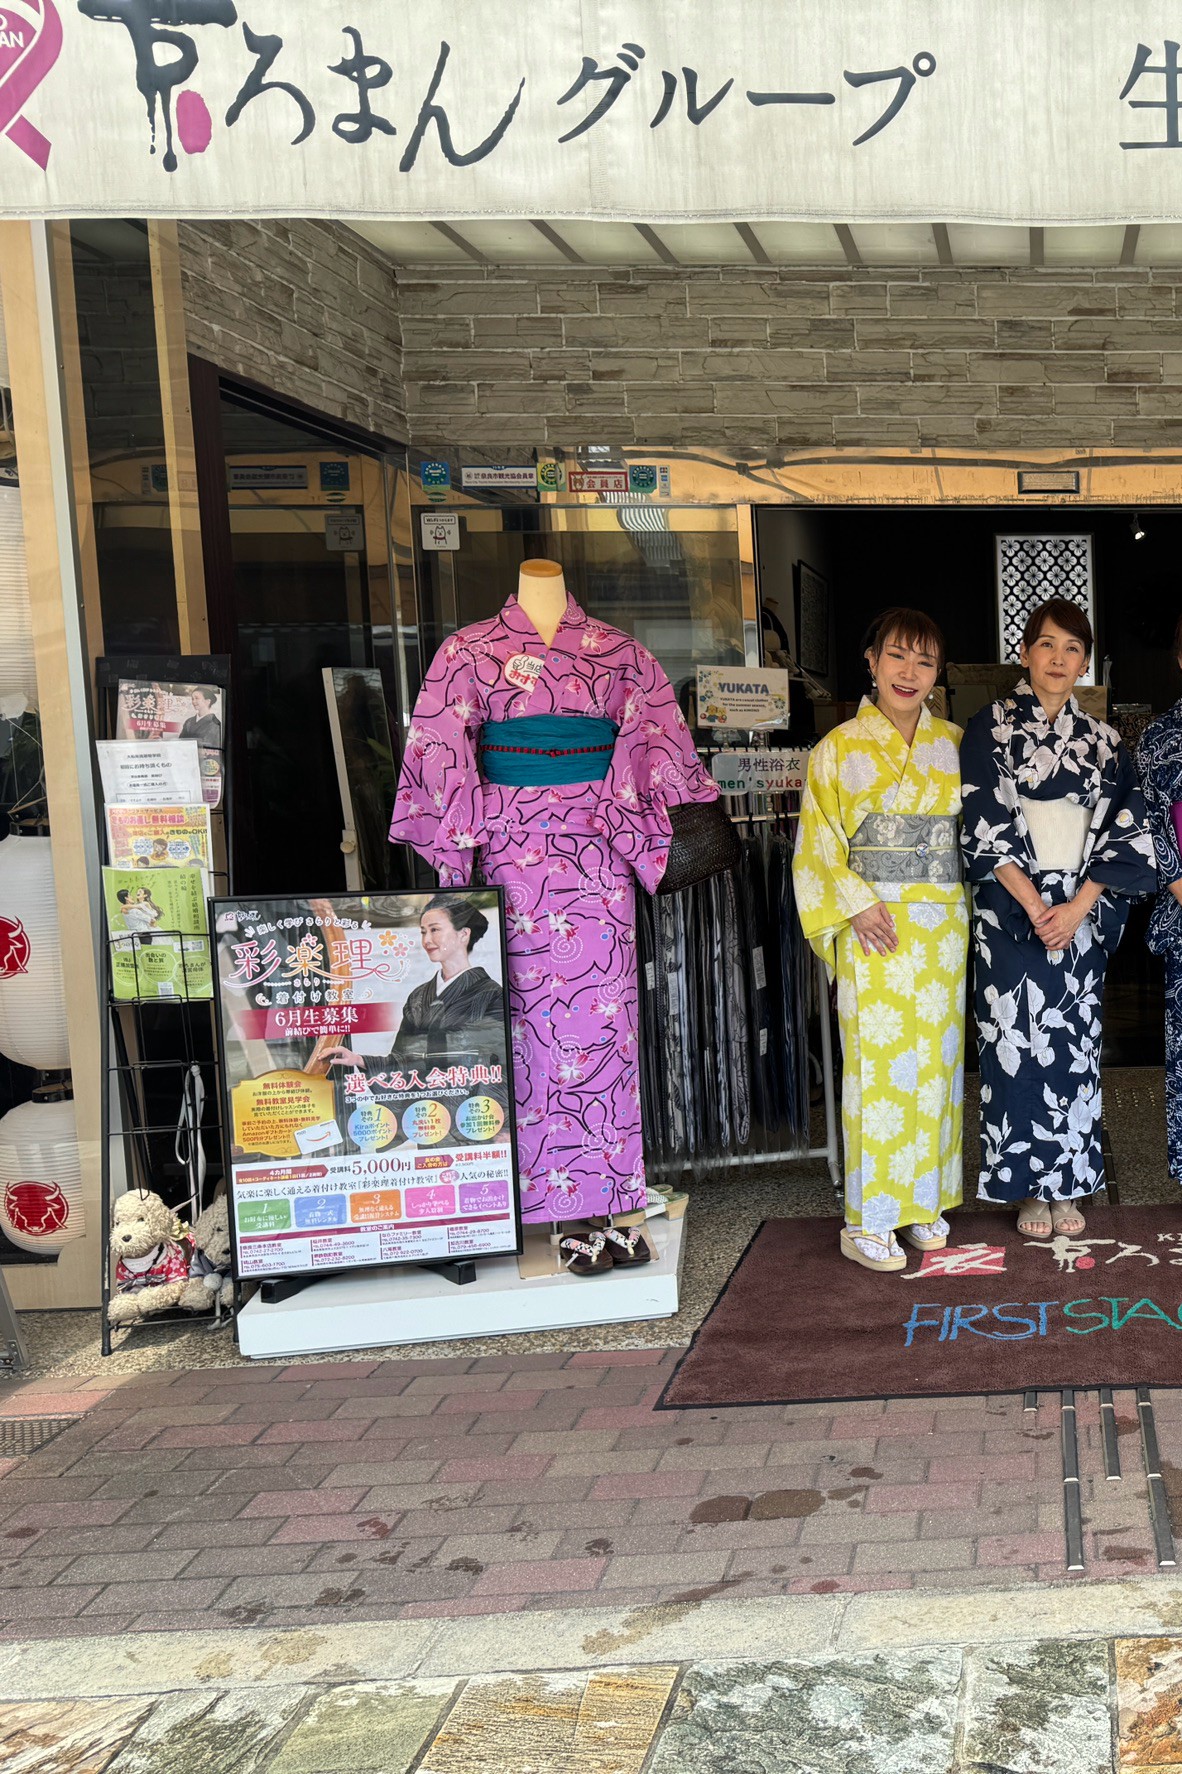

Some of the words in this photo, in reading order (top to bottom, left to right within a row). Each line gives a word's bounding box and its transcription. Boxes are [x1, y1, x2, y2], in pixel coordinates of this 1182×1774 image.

[718, 682, 769, 695] YUKATA
[738, 757, 800, 773] 男性浴衣
[226, 937, 374, 983] 彩楽理
[293, 977, 321, 988] さらり
[276, 989, 354, 1005] 着付け教室
[275, 1006, 359, 1028] 6月生募集
[344, 1064, 503, 1095] 選べる入会特典!!
[352, 1157, 411, 1175] 5,000円
[903, 1300, 1059, 1347] FIRST
